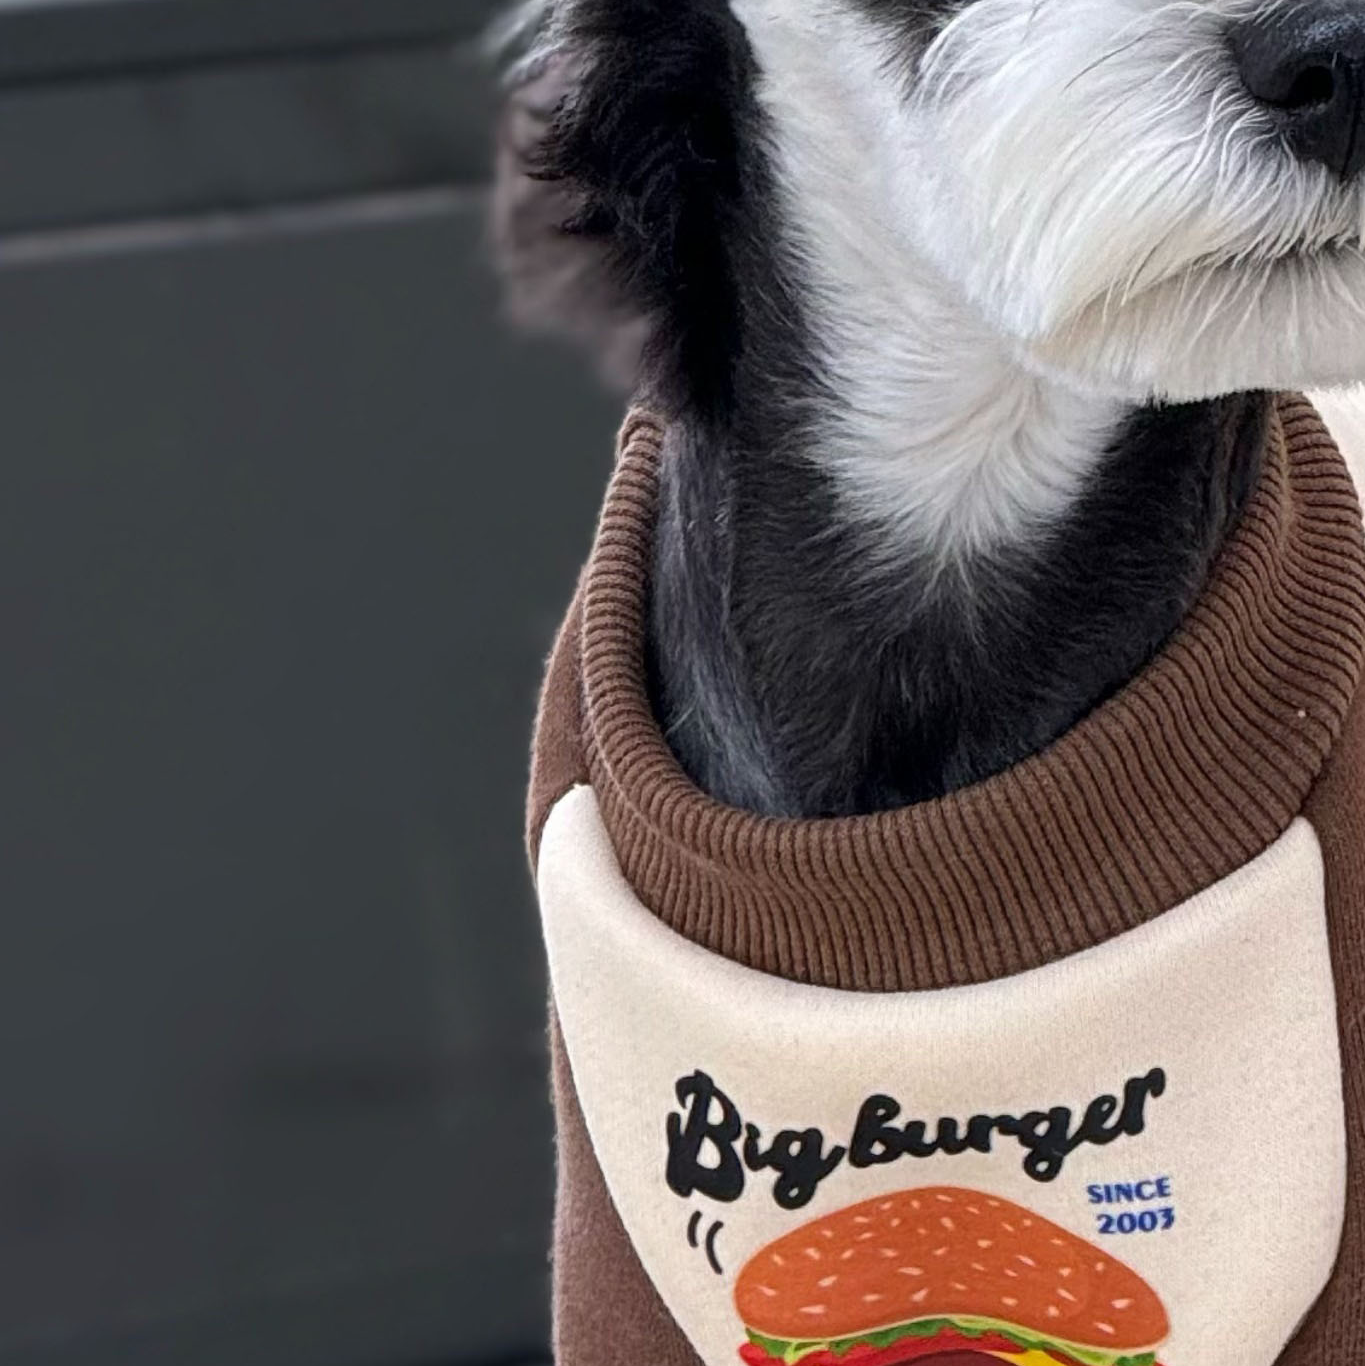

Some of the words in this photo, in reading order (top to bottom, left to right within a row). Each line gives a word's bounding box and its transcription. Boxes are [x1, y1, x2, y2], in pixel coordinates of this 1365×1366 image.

[665, 1068, 848, 1211] Big
[847, 1066, 1167, 1184] burger
[1086, 1176, 1173, 1207] SINCE
[1096, 1206, 1176, 1235] 2003
